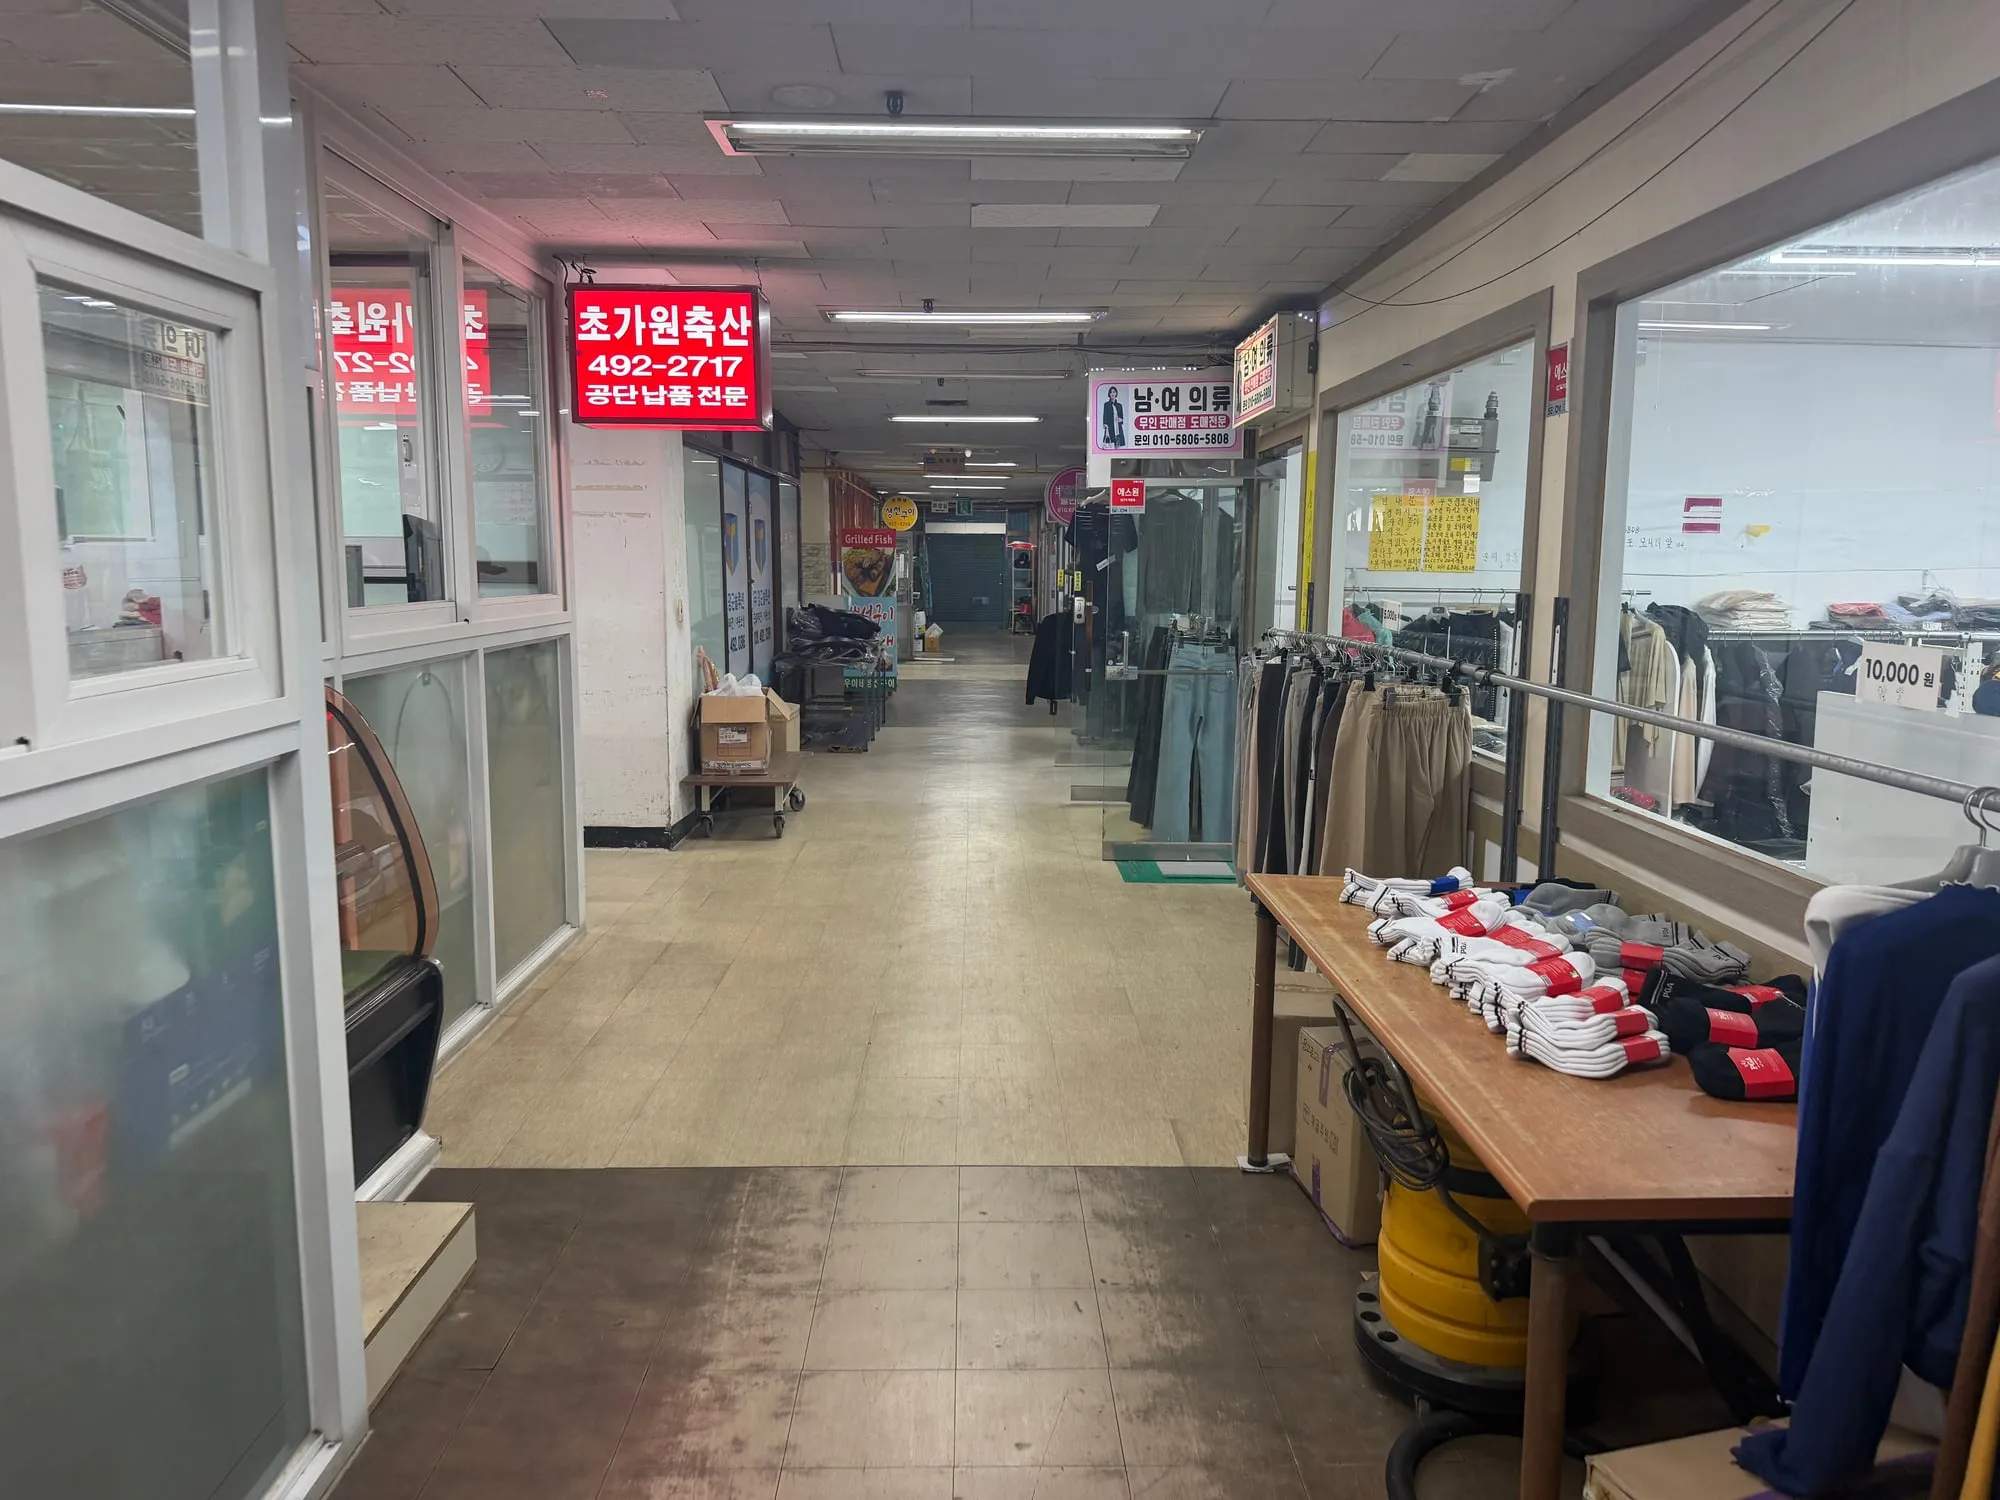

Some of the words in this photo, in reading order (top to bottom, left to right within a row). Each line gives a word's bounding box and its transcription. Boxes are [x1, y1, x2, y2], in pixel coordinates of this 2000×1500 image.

[577, 304, 752, 348] 초가원축산
[588, 354, 743, 377] 492-2717
[1554, 362, 1567, 381] 에스
[585, 384, 638, 405] 공단
[641, 385, 694, 407] 납품
[697, 386, 749, 407] 전문
[1134, 386, 1180, 413] 남·여
[1139, 416, 1158, 430] 무인
[1160, 415, 1187, 430] 판매점
[1190, 415, 1228, 429] 도매전문
[1134, 434, 1150, 447] 문의
[1116, 487, 1140, 497] 에스원
[885, 506, 915, 520] 생선구이
[845, 533, 874, 545] Grilled
[874, 533, 893, 545] Fish
[1865, 658, 1919, 686] 10,000
[1923, 672, 1935, 688] 원
[1662, 981, 1675, 1000] PGA
